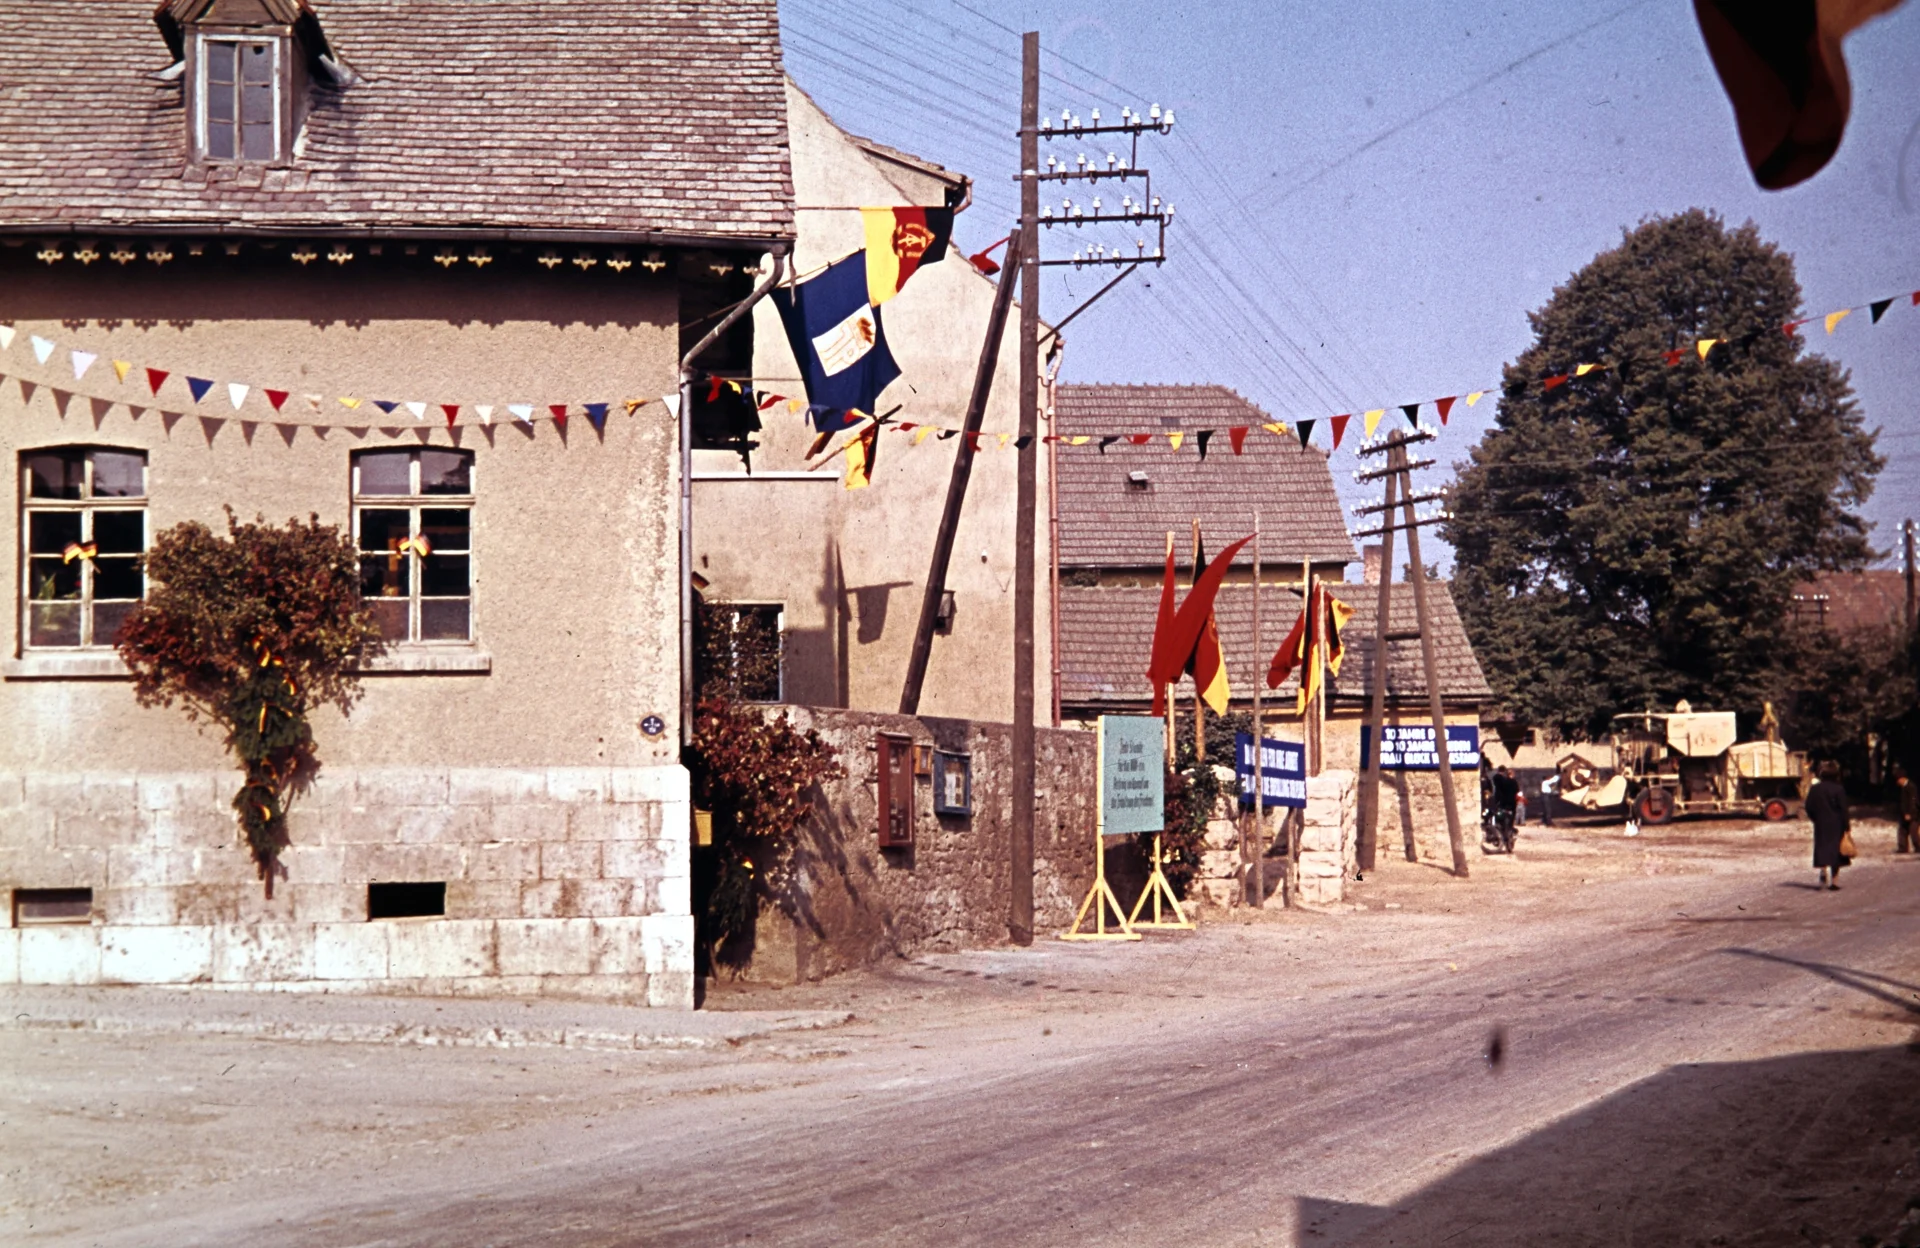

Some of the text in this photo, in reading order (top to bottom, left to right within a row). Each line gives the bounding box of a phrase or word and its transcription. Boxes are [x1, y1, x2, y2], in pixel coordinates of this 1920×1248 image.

[1385, 728, 1396, 739] 10
[1398, 728, 1425, 739] JAHRE
[1395, 741, 1405, 751] 10
[1407, 741, 1435, 751] JAHRE
